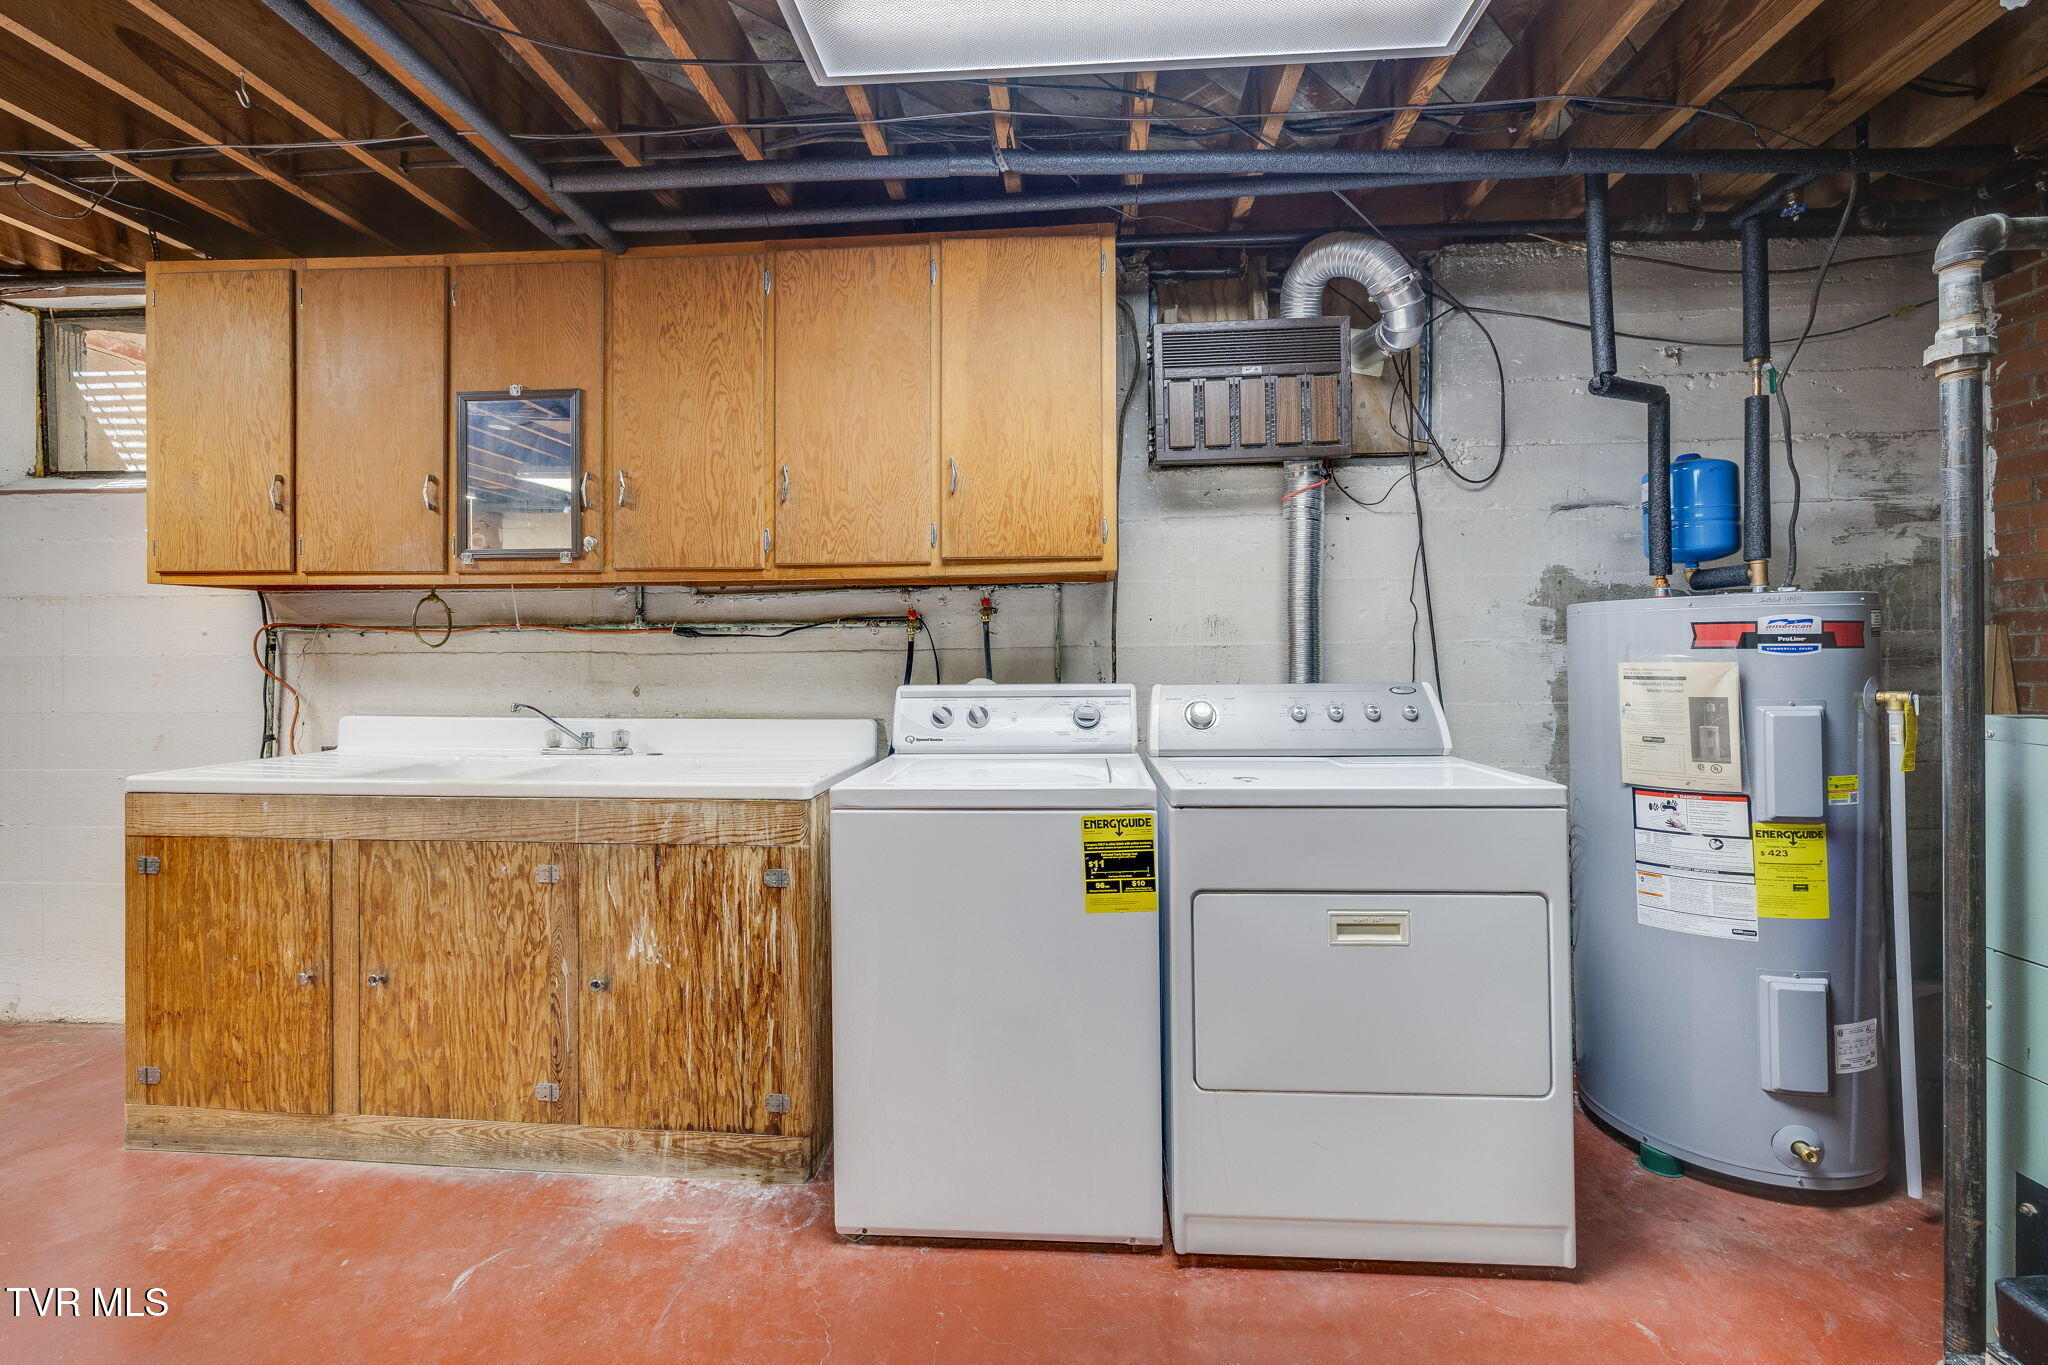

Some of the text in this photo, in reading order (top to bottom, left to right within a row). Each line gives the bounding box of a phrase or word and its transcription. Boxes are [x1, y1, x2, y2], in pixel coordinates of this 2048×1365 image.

[1083, 817, 1152, 829] ENERGYGUIDE
[1755, 829, 1824, 839] ENERGYGUIDE
[1768, 849, 1789, 857] 423
[1088, 859, 1105, 868] $11
